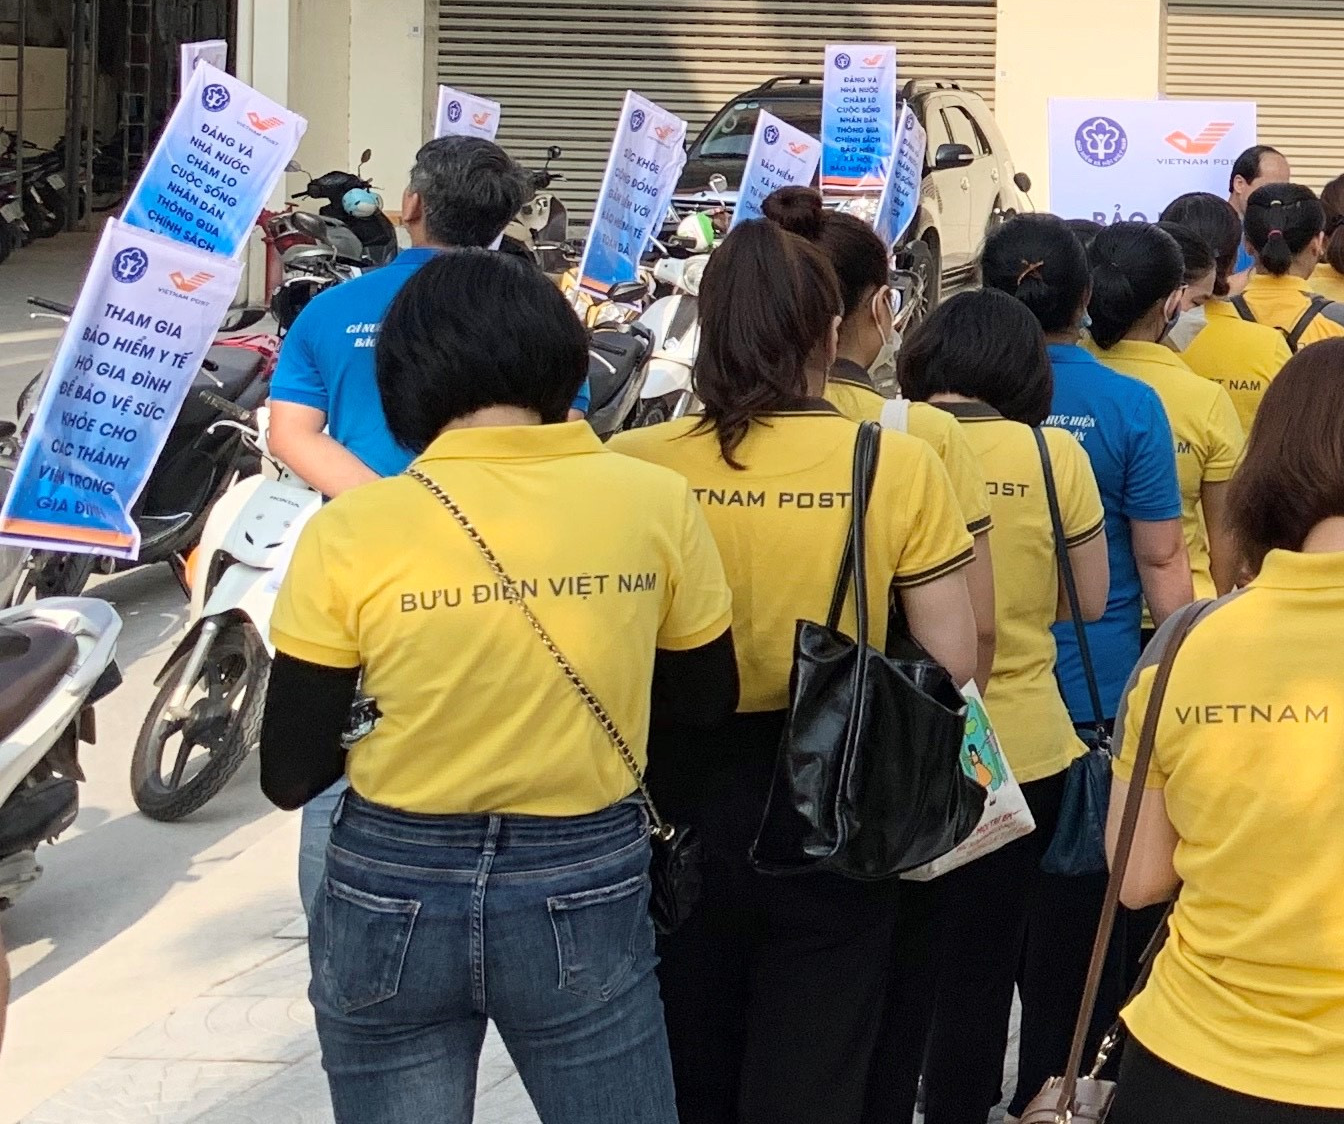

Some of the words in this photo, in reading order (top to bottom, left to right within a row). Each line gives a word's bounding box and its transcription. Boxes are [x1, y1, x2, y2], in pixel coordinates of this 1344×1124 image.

[190, 136, 212, 156] NHÀ
[215, 152, 250, 175] NƯỚC
[201, 123, 235, 147] ĐẢNG
[239, 142, 252, 158] VÀ
[187, 154, 220, 179] CHĂM
[222, 173, 237, 187] LO
[1156, 158, 1209, 166] VIETNAM
[167, 181, 198, 205] NHÂN
[200, 200, 225, 220] DÂN
[171, 164, 203, 188] CUỘC
[204, 185, 237, 207] SỐNG
[148, 209, 182, 233] CHÍNH
[183, 231, 215, 253] SÁCH
[157, 194, 193, 221] THÔNG
[196, 219, 219, 237] QUA
[105, 304, 152, 329] THAM
[155, 319, 182, 339] GIA
[82, 327, 110, 346] BẢO
[113, 336, 154, 360] HIỂM
[159, 349, 171, 363] Y
[173, 351, 193, 369] TẾ
[74, 355, 93, 372] HỘ
[97, 362, 124, 381] GIA
[132, 370, 171, 394] ĐÌNH
[1229, 379, 1261, 391] NAM
[75, 386, 106, 405] BẢO
[111, 395, 132, 417] VỆ
[136, 402, 165, 421] SỨC
[100, 423, 137, 443] CHO
[77, 445, 130, 470] THÀNH
[692, 488, 765, 508] TNAM
[778, 491, 851, 509] POST
[400, 588, 461, 613] BƯU
[549, 573, 610, 601] VIỆT
[618, 573, 657, 593] NAM
[1175, 704, 1328, 725] VIETNAM
